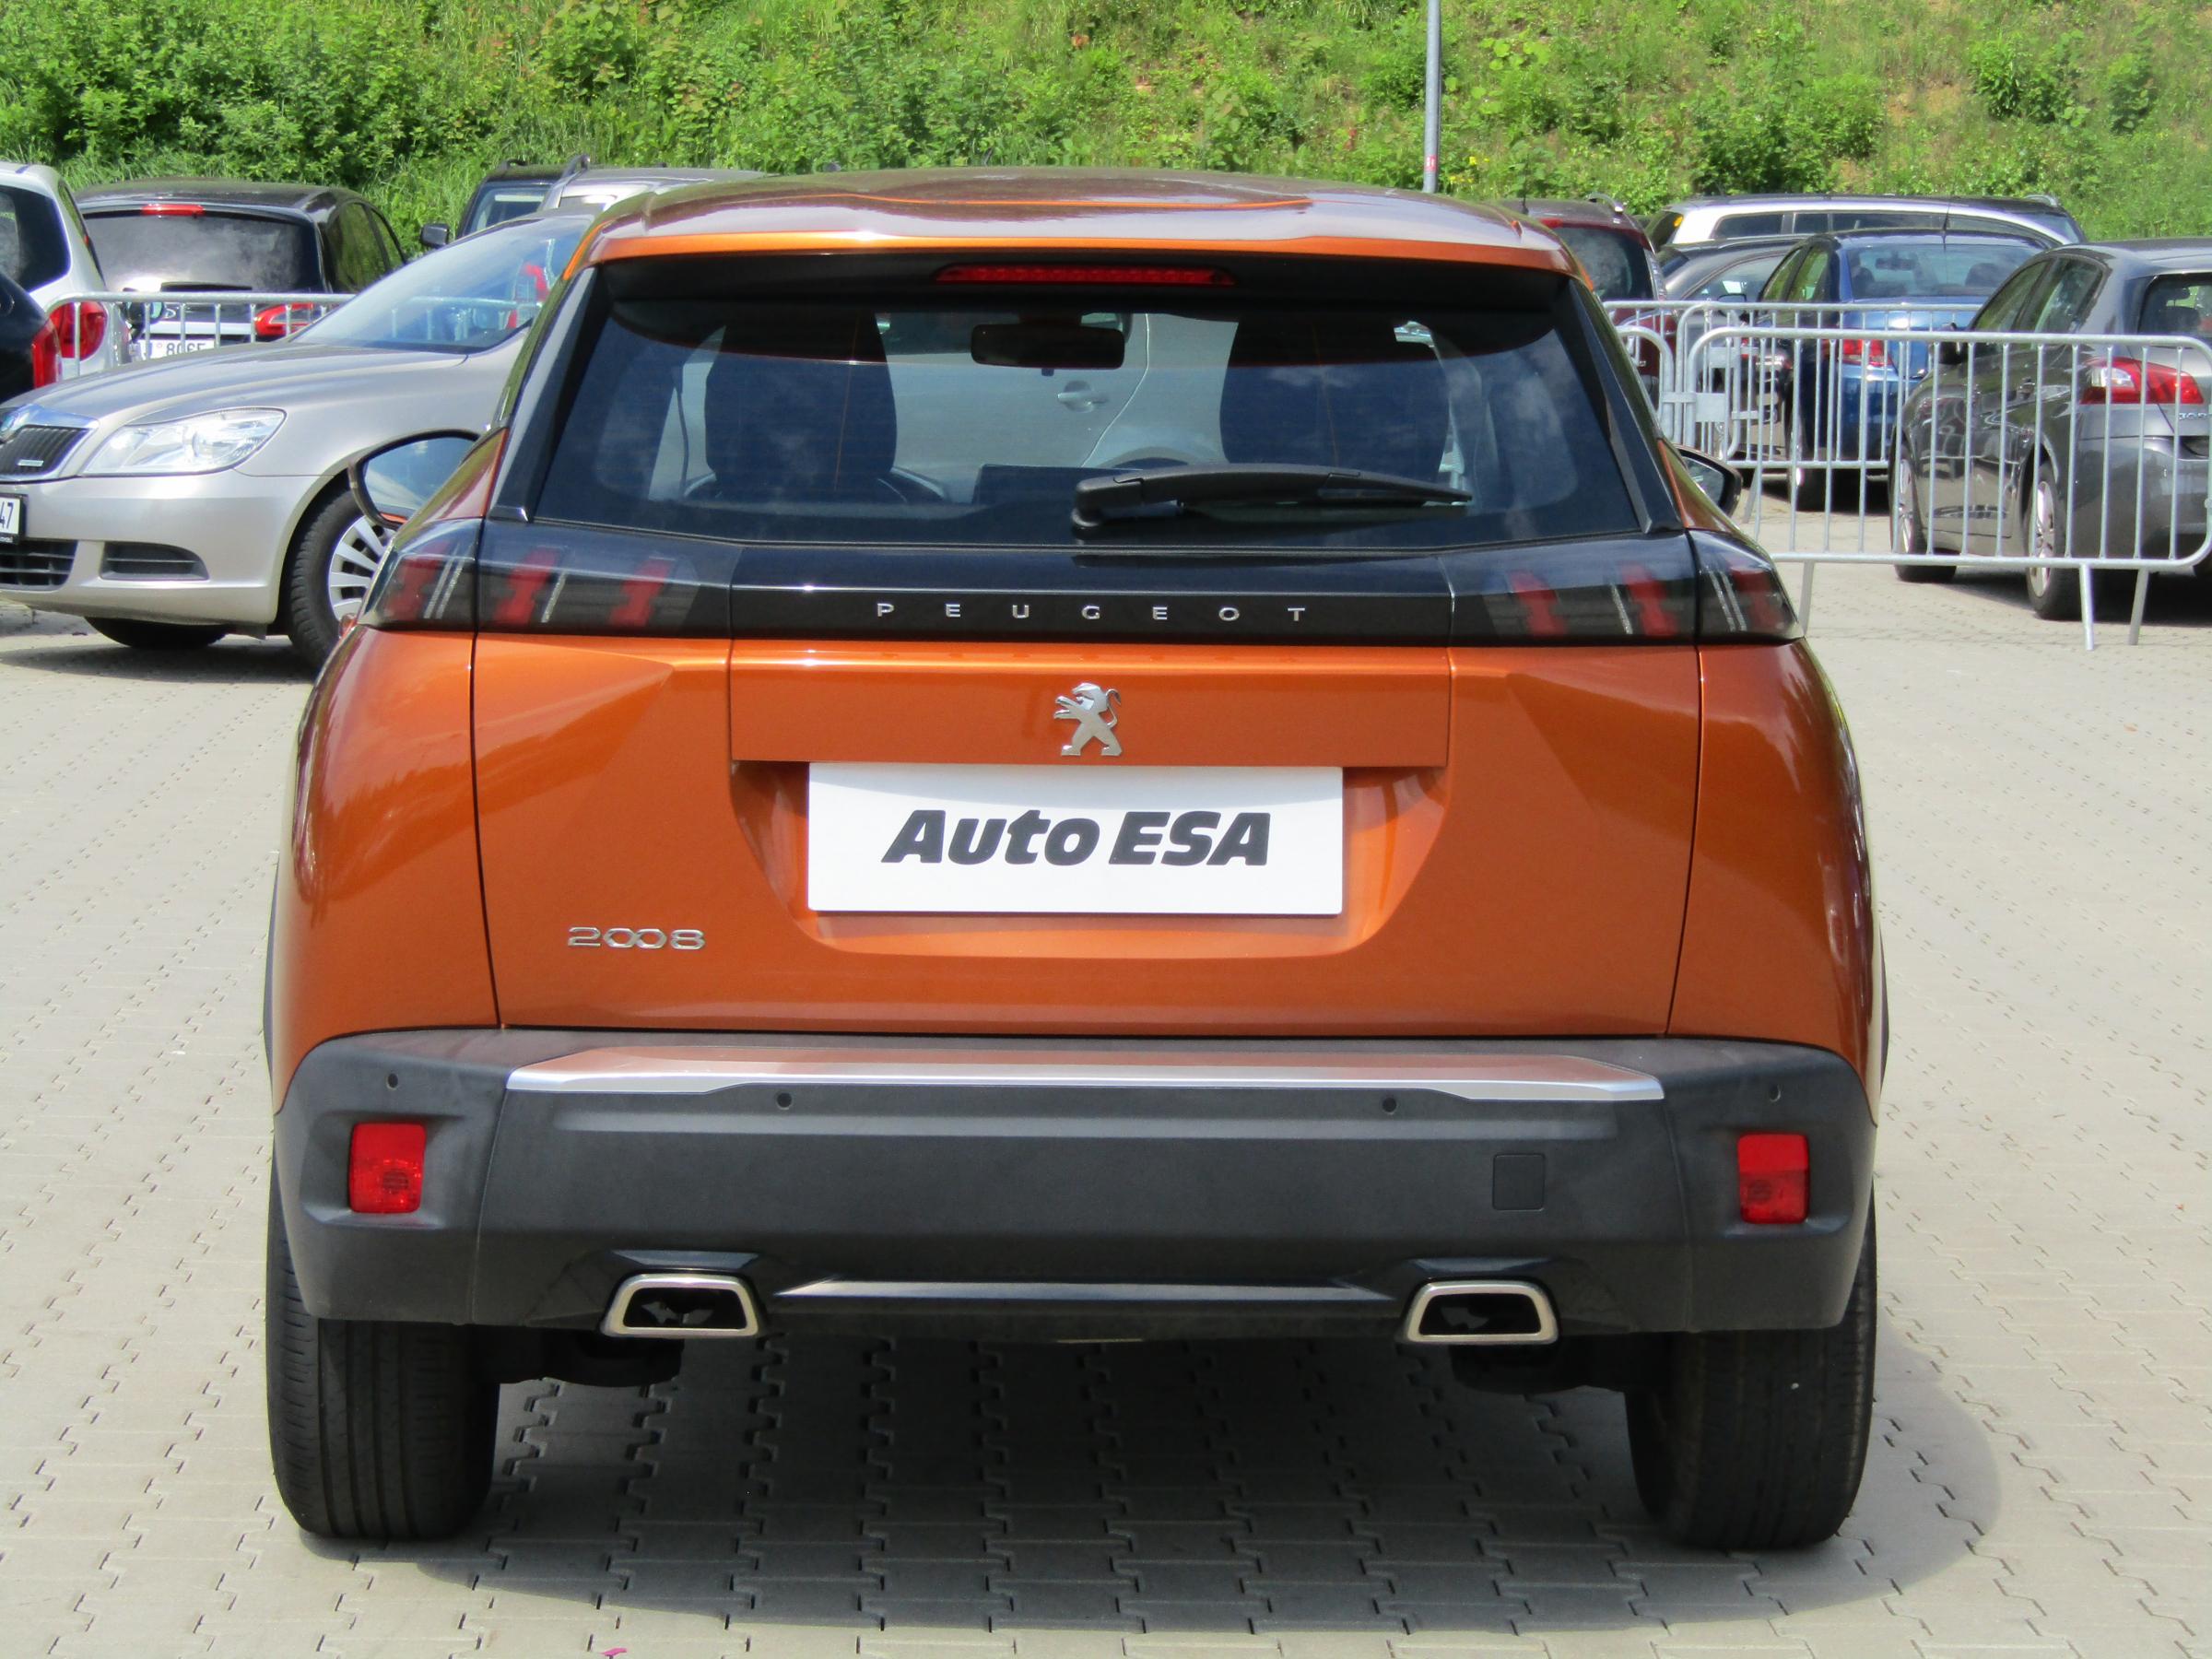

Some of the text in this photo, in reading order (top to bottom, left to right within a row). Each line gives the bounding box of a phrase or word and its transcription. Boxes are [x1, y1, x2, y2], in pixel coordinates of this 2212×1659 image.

[877, 602, 1306, 622] PEUGEOT
[880, 809, 1272, 866] Auto ESA
[567, 926, 706, 950] 2008
